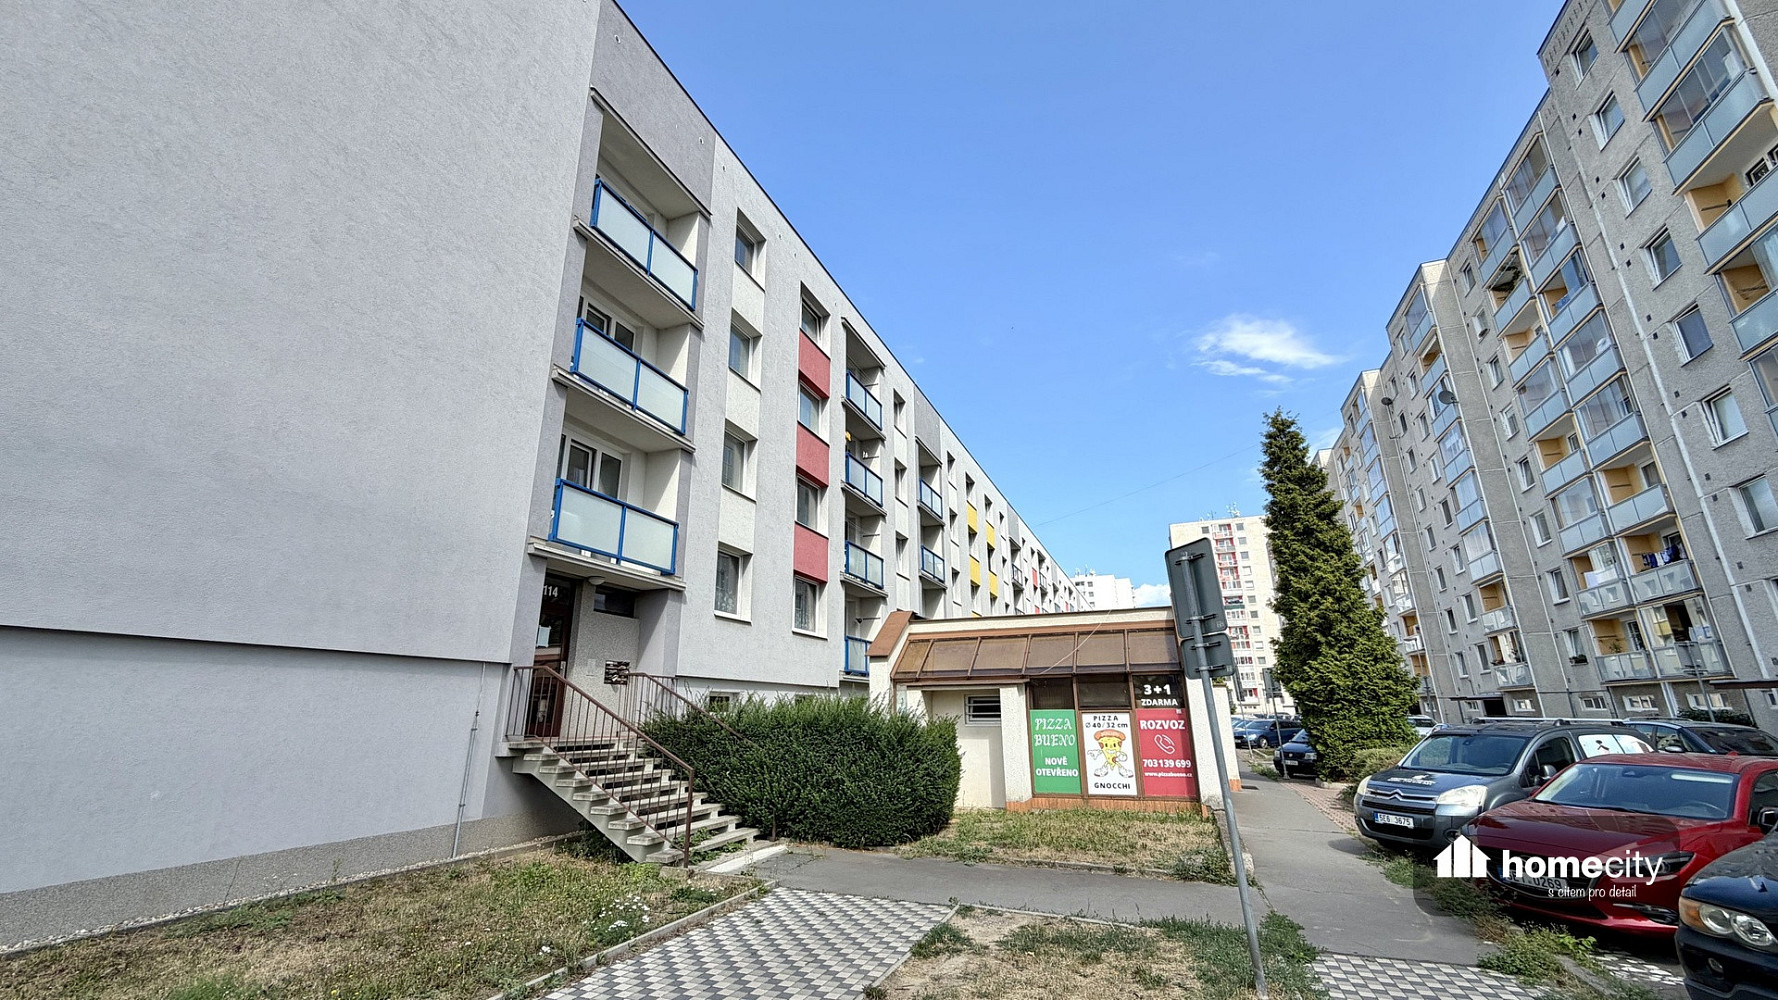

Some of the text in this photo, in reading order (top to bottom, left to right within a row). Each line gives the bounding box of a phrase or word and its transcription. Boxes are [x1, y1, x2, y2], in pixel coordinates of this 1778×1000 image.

[1143, 684, 1171, 695] 3+1
[1141, 698, 1178, 706] ZDARMA
[1034, 718, 1072, 730] PIZZA
[1139, 719, 1185, 730] ROZVOZ
[1034, 734, 1076, 747] BUENO
[1045, 756, 1068, 766] NOVĚ
[1142, 759, 1158, 768] 703
[1175, 759, 1191, 768] 699
[1035, 767, 1079, 777] OTEVŘENO
[1094, 782, 1131, 790] GNOCCHI
